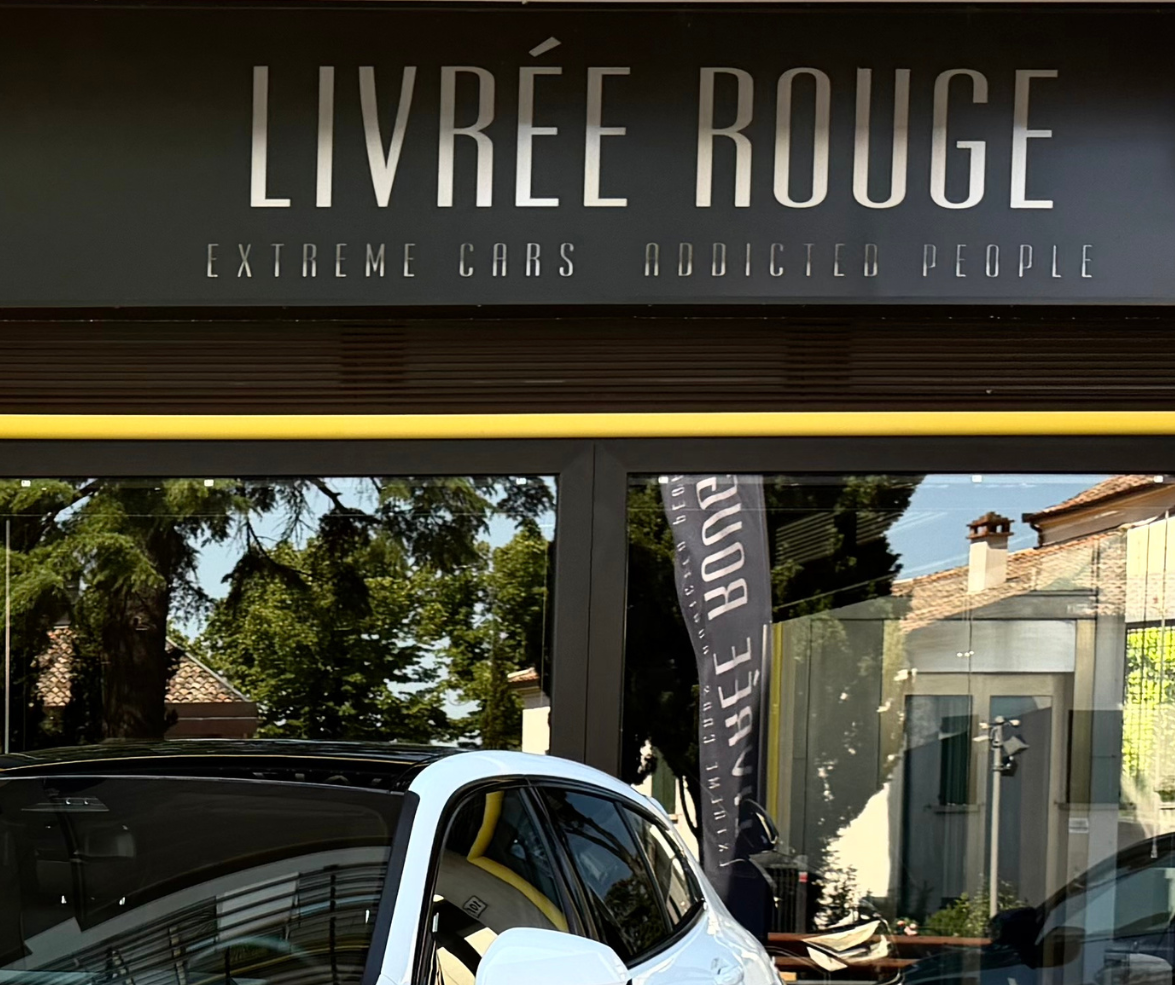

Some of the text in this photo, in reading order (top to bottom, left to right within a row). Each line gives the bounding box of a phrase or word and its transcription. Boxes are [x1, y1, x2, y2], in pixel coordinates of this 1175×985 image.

[250, 36, 1059, 210] LIVRÉE ROUGE
[206, 242, 1094, 280] EXTREME CARS ADDICTED PEOPLE
